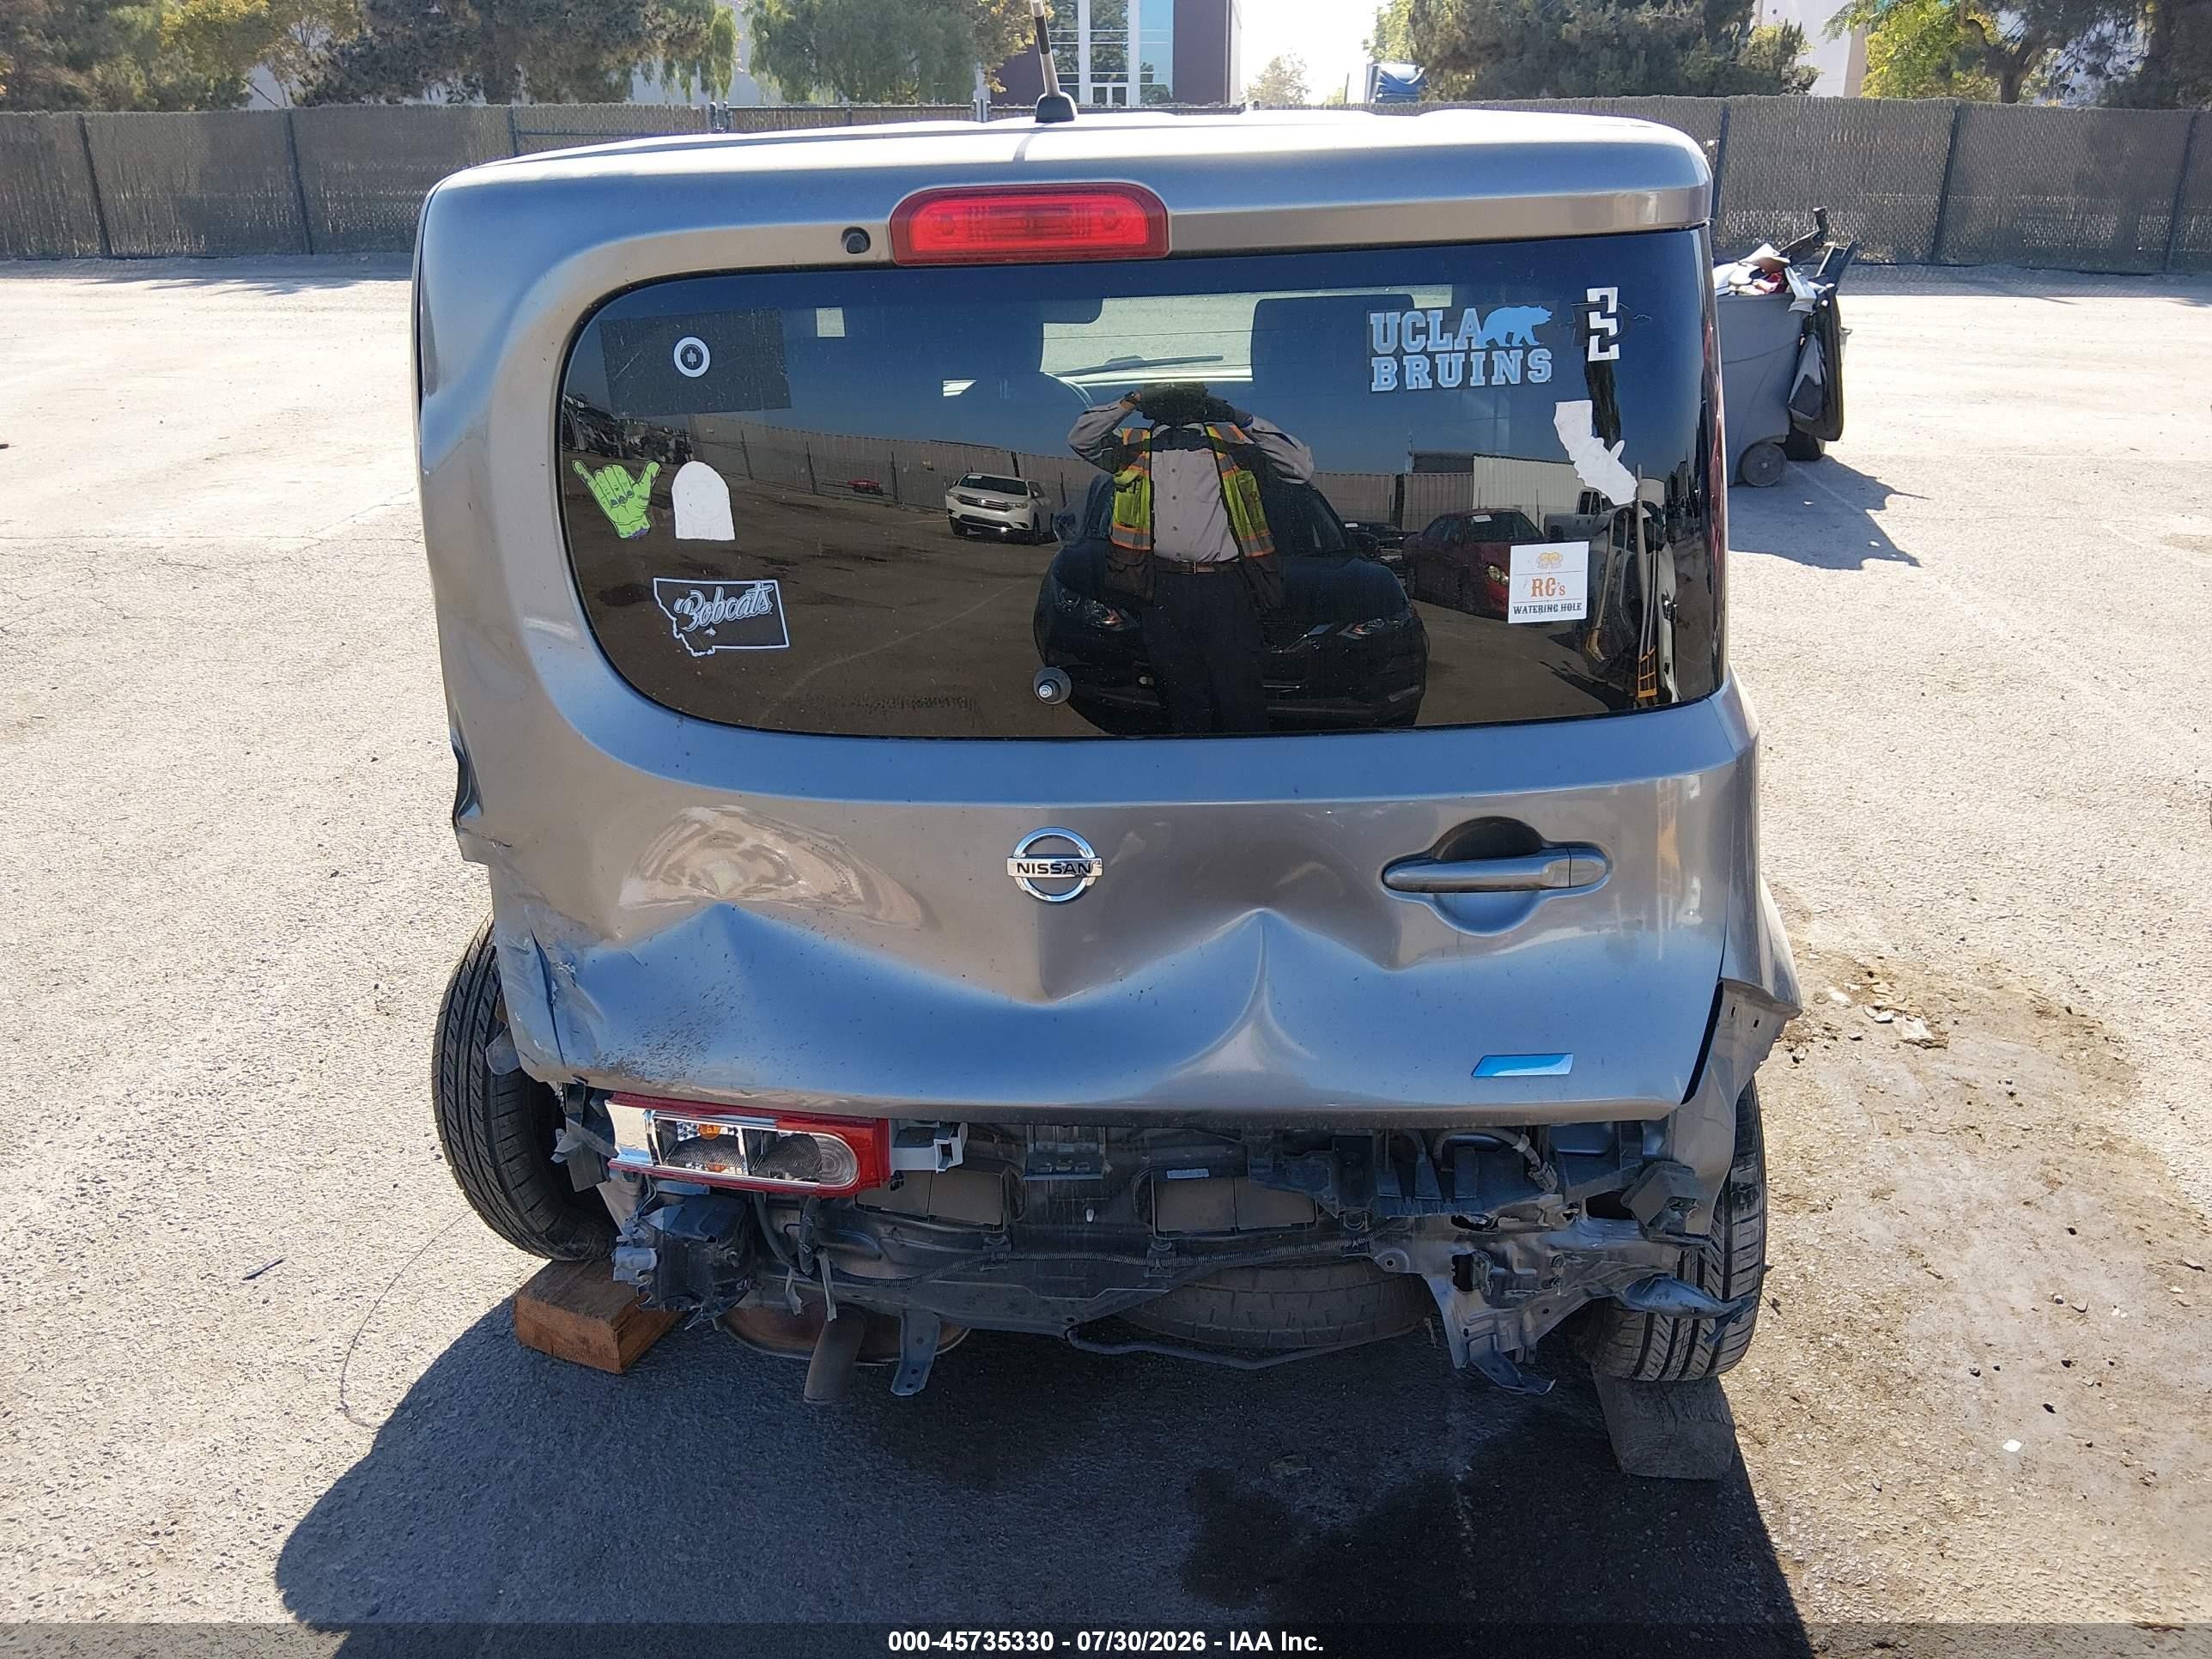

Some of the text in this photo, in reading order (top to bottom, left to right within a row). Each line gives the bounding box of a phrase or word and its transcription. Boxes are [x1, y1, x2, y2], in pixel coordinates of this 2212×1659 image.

[1370, 307, 1489, 355] UCLA
[1370, 348, 1553, 392] BRUINS
[1531, 577, 1566, 598] RC's
[673, 581, 774, 632] Bobcats
[1513, 602, 1583, 615] WATERING HOLE
[1017, 862, 1091, 875] NISSAN
